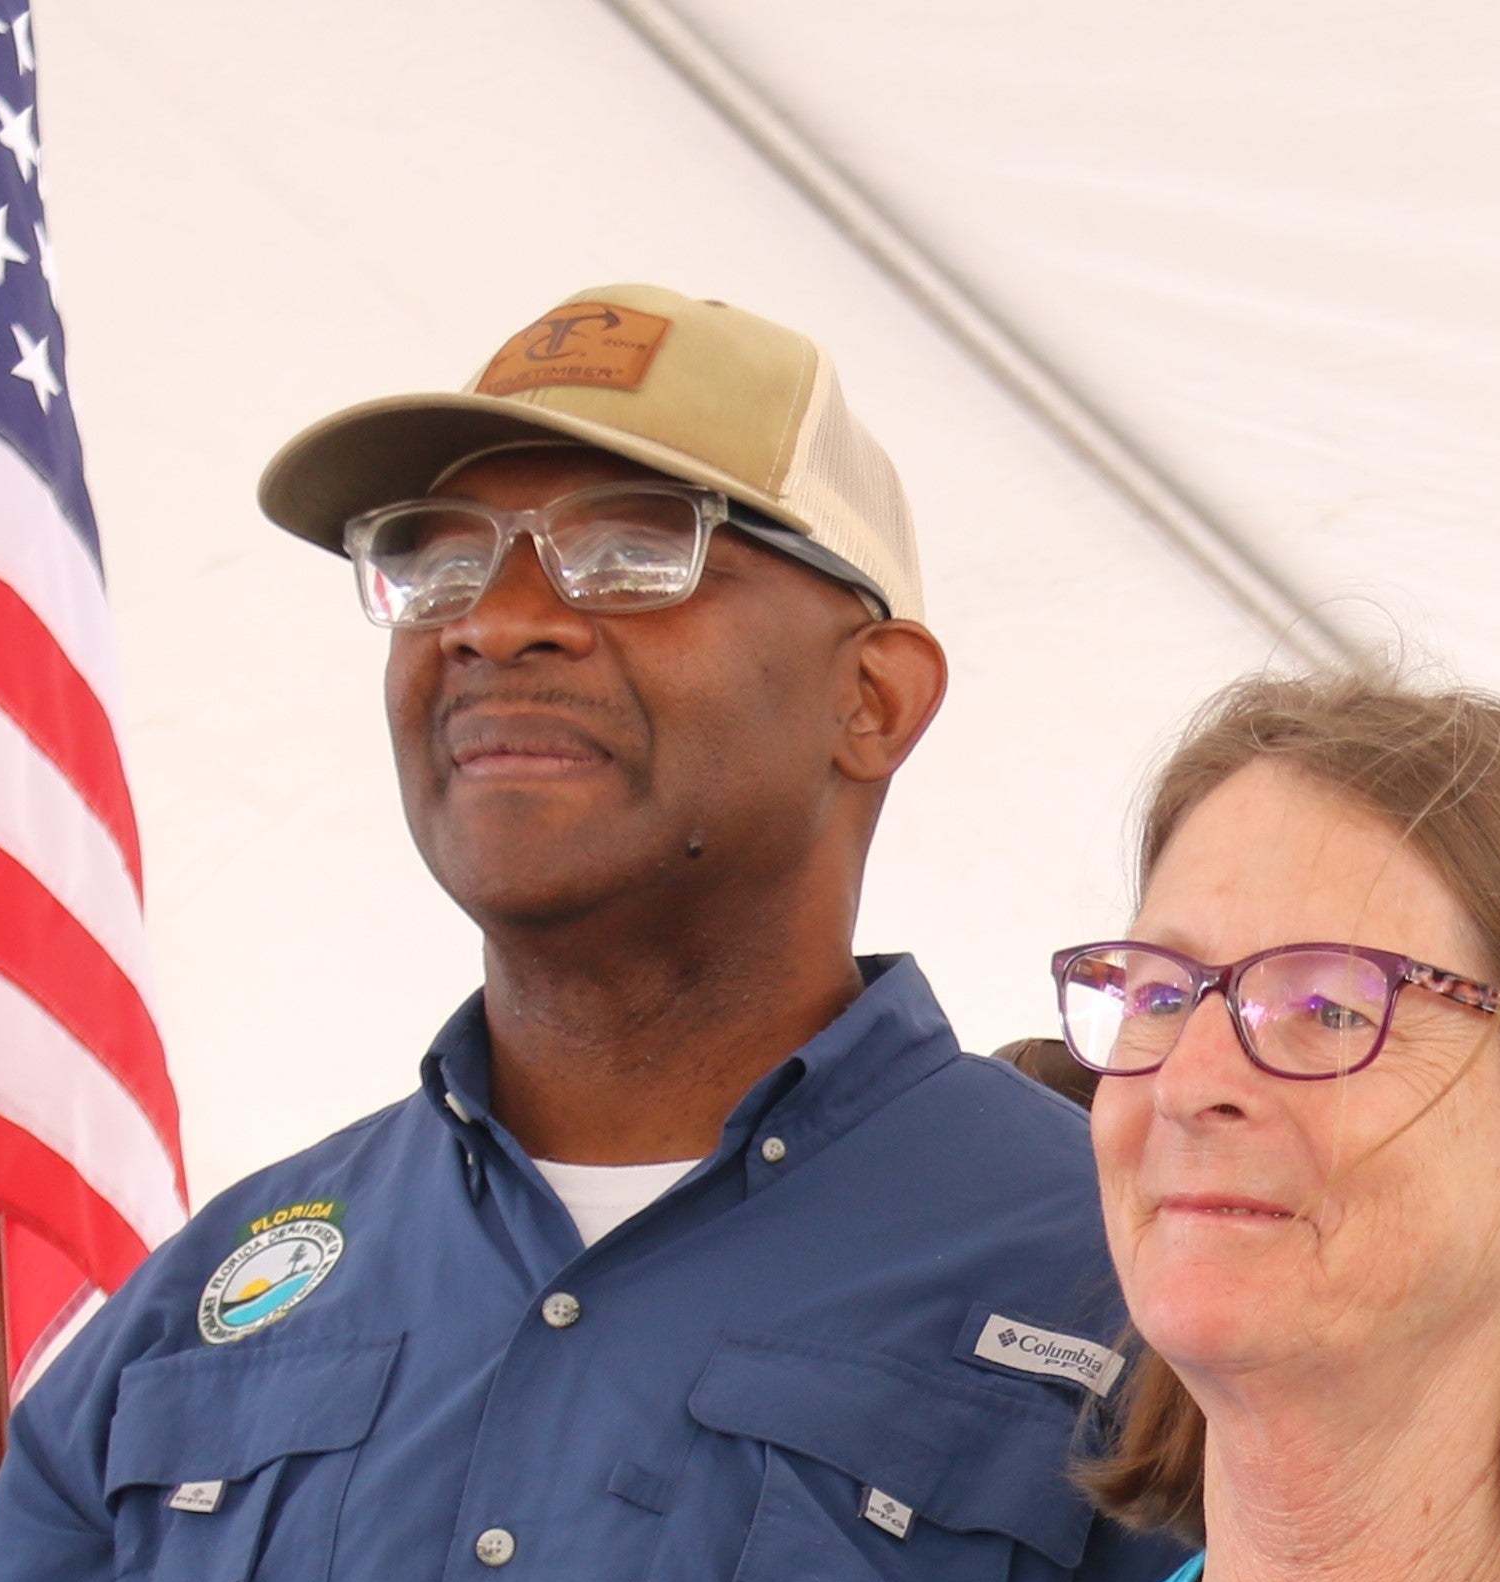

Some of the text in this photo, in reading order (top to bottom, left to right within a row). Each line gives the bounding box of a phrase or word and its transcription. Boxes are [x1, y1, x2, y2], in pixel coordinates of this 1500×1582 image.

[250, 1203, 333, 1235] FLORIDA
[211, 1240, 263, 1289] FLORIDA
[1019, 1334, 1103, 1372] Columbia
[1043, 1357, 1097, 1380] PFG
